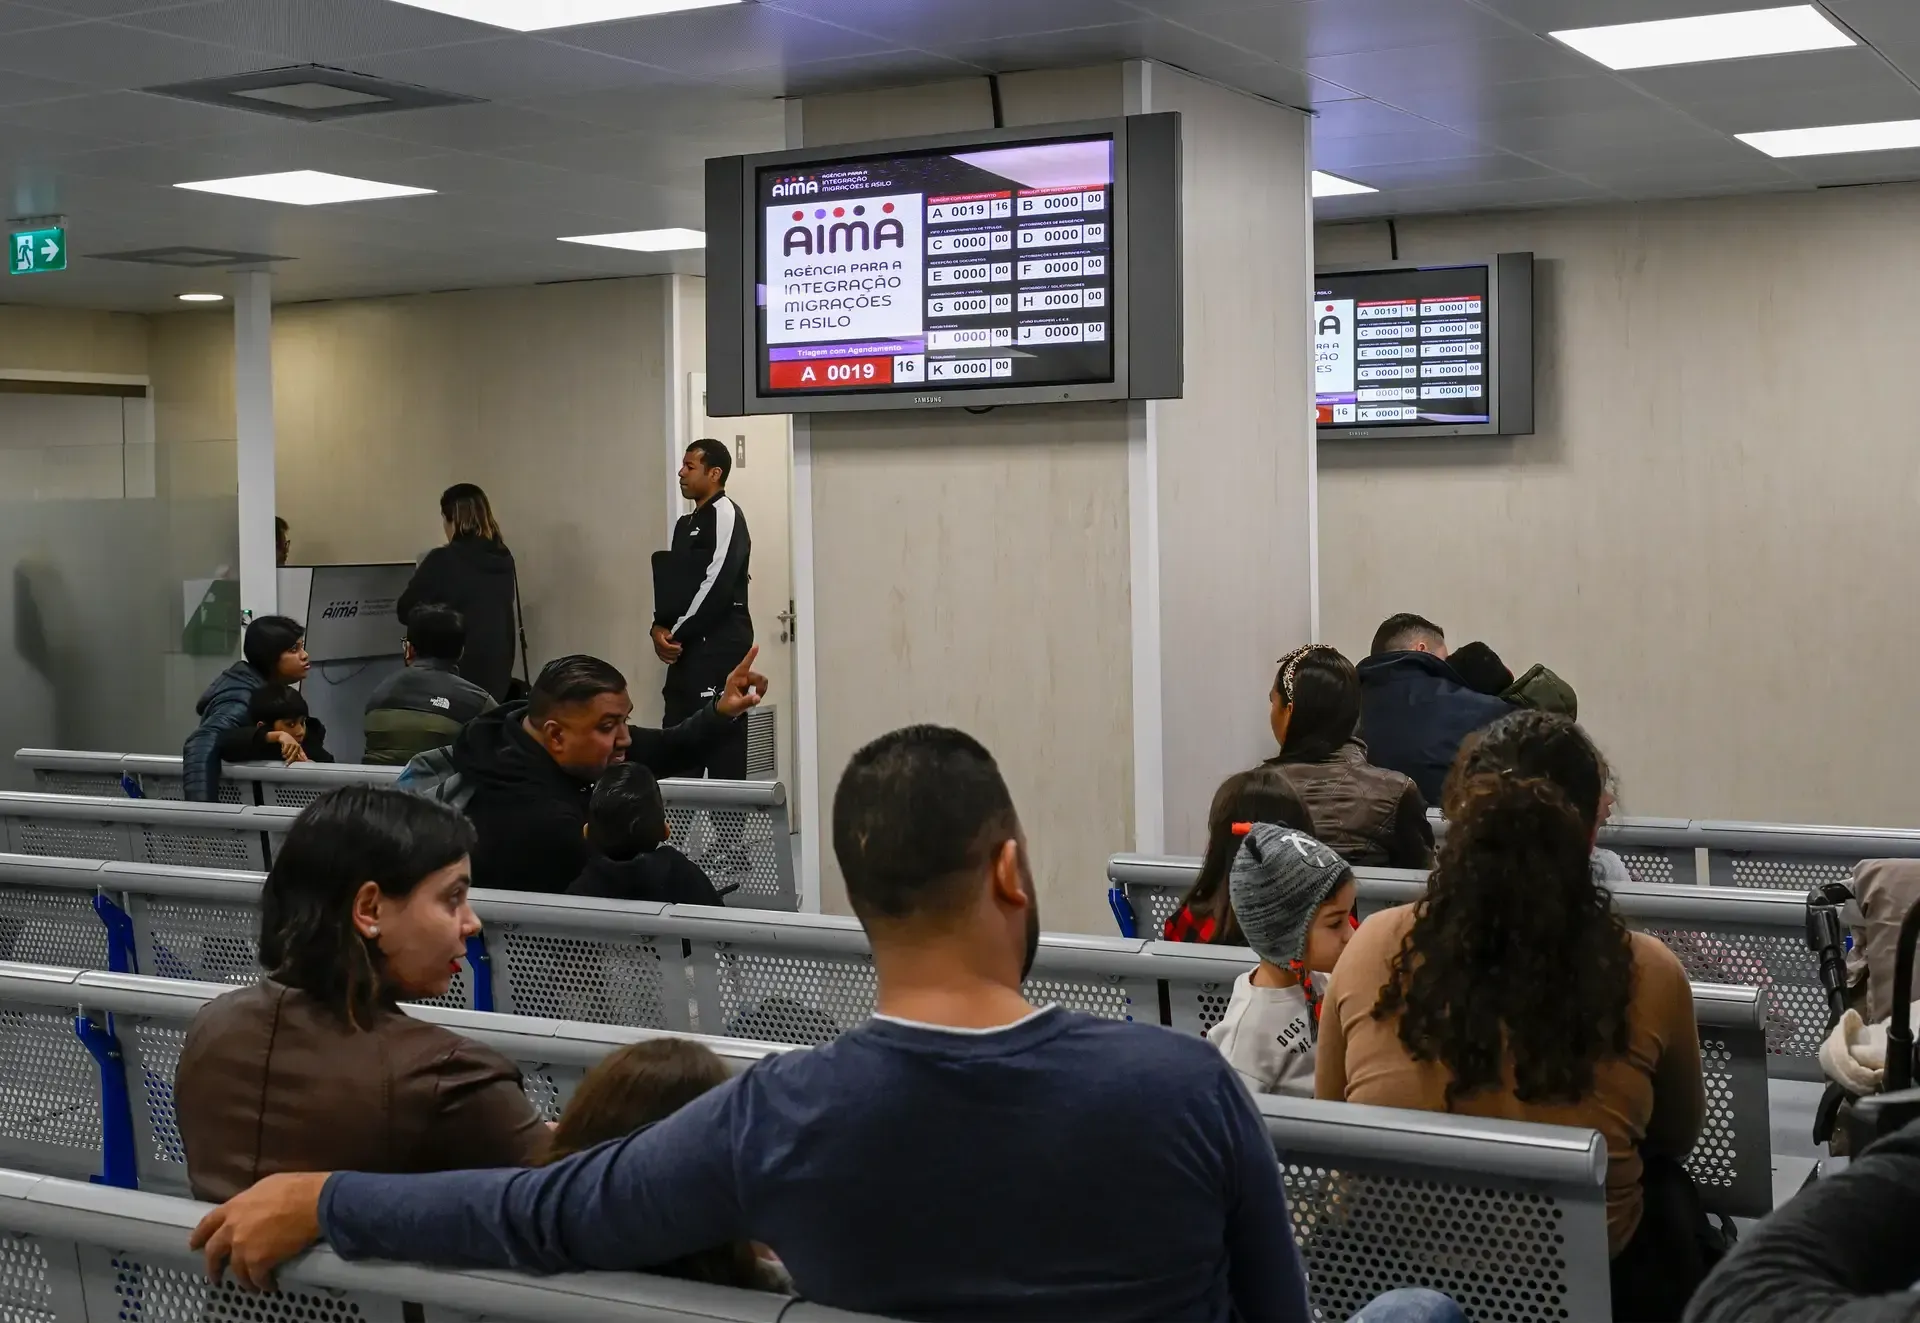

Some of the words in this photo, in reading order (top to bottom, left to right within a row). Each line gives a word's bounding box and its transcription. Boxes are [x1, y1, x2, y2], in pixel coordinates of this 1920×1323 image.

[772, 180, 818, 197] AIMA
[822, 176, 867, 185] INTEGRAÇÃO
[822, 183, 864, 192] MIGRAÇÕES
[932, 208, 943, 218] A
[952, 204, 984, 216] 0019
[996, 202, 1008, 210] 16
[1023, 201, 1033, 211] B
[1044, 196, 1078, 209] 0000
[1088, 194, 1101, 202] 00
[783, 218, 904, 257] AIMA
[933, 240, 942, 250] C
[953, 236, 986, 248] 0000
[995, 234, 1008, 243] 00
[1023, 233, 1033, 243] D
[1044, 230, 1078, 241] 0000
[1088, 227, 1101, 235] 00
[784, 264, 847, 278] AGÊNCIA
[851, 261, 888, 273] PARA
[892, 261, 902, 270] A
[933, 271, 942, 281] E
[953, 268, 986, 280] 0000
[995, 265, 1008, 274] 00
[1023, 264, 1032, 275] F
[1045, 261, 1078, 273] 0000
[1088, 259, 1102, 268] 00
[784, 275, 901, 295] INTEGRAÇÃO
[784, 294, 892, 313] MIGRAÇÕES
[933, 303, 943, 312] G
[954, 299, 986, 311] 0000
[995, 297, 1008, 306] 00
[1023, 296, 1033, 307] H
[1045, 294, 1079, 305] 0000
[1088, 292, 1102, 300] 00
[785, 319, 794, 330] E
[800, 316, 850, 329] ASILO
[1023, 328, 1031, 338] J
[1045, 326, 1079, 337] 0000
[1088, 324, 1102, 332] 00
[954, 331, 986, 342] 0000
[996, 329, 1008, 338] 00
[848, 345, 901, 354] Agendamento
[801, 366, 816, 381] A
[827, 364, 875, 380] 0019
[897, 361, 914, 372] 16
[933, 365, 943, 375] K
[954, 363, 987, 374] 0000
[996, 361, 1008, 369] 00
[1376, 369, 1399, 377] 0000
[322, 606, 358, 618] AIMA
[1276, 1018, 1305, 1047] DOGS
